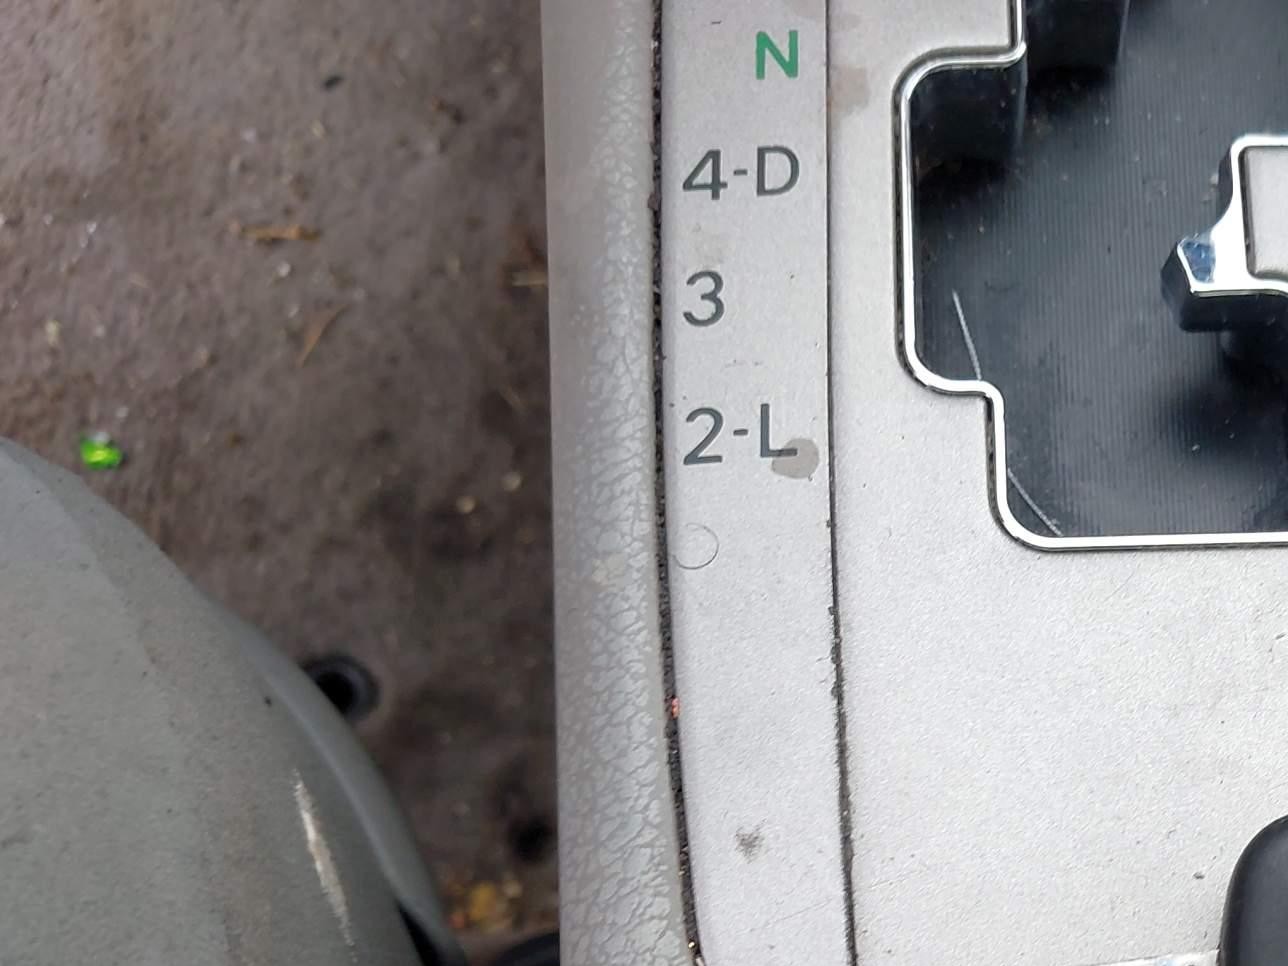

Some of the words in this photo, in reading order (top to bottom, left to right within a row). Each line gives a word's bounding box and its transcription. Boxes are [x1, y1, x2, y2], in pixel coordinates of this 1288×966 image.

[755, 29, 799, 79] N
[682, 145, 800, 200] 4-D
[682, 270, 724, 327] 3
[682, 403, 799, 466] 2-L
